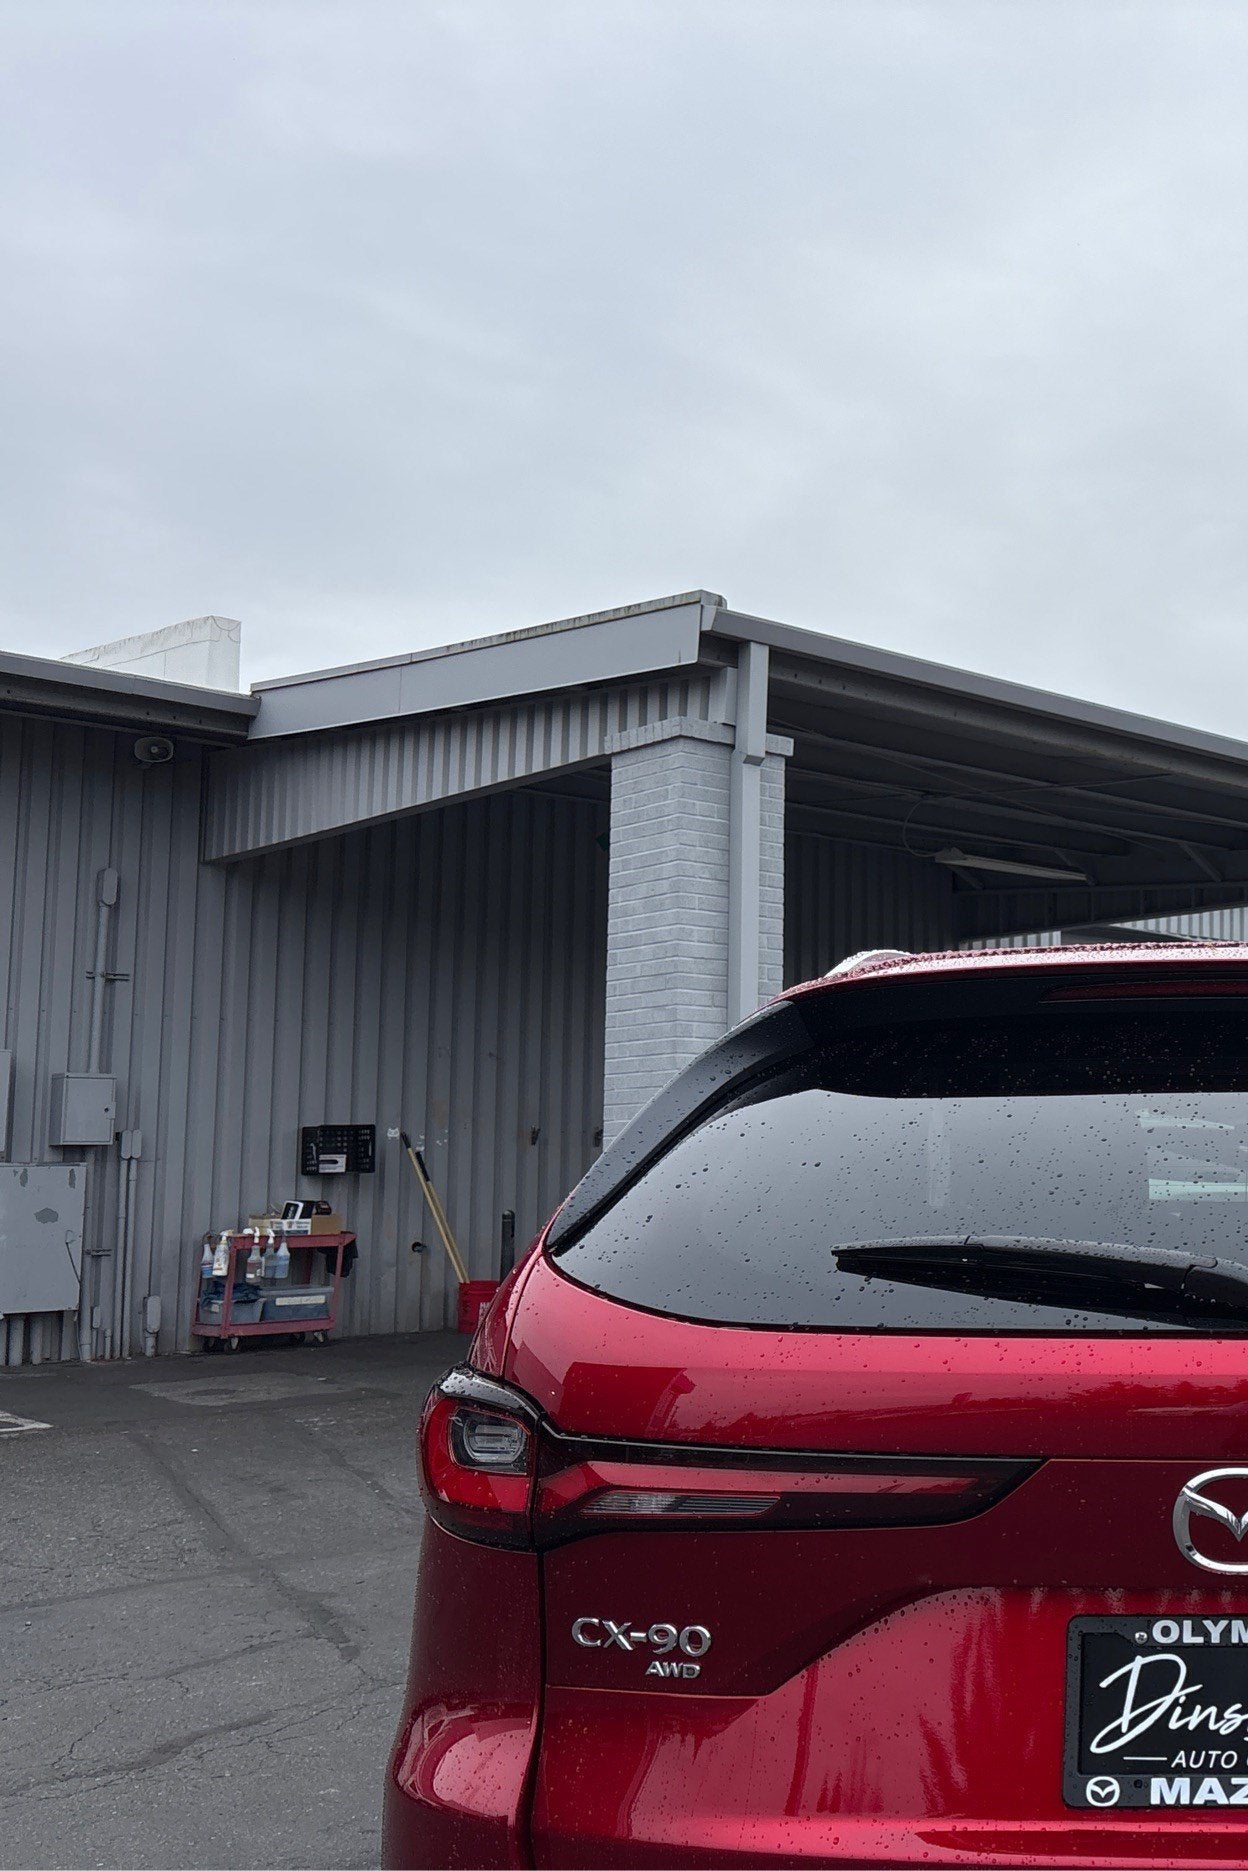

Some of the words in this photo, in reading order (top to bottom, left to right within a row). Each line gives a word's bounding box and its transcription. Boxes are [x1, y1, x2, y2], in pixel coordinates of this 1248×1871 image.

[571, 1616, 712, 1657] CX-90
[645, 1660, 701, 1679] AWD
[1171, 1750, 1238, 1769] AUTO
